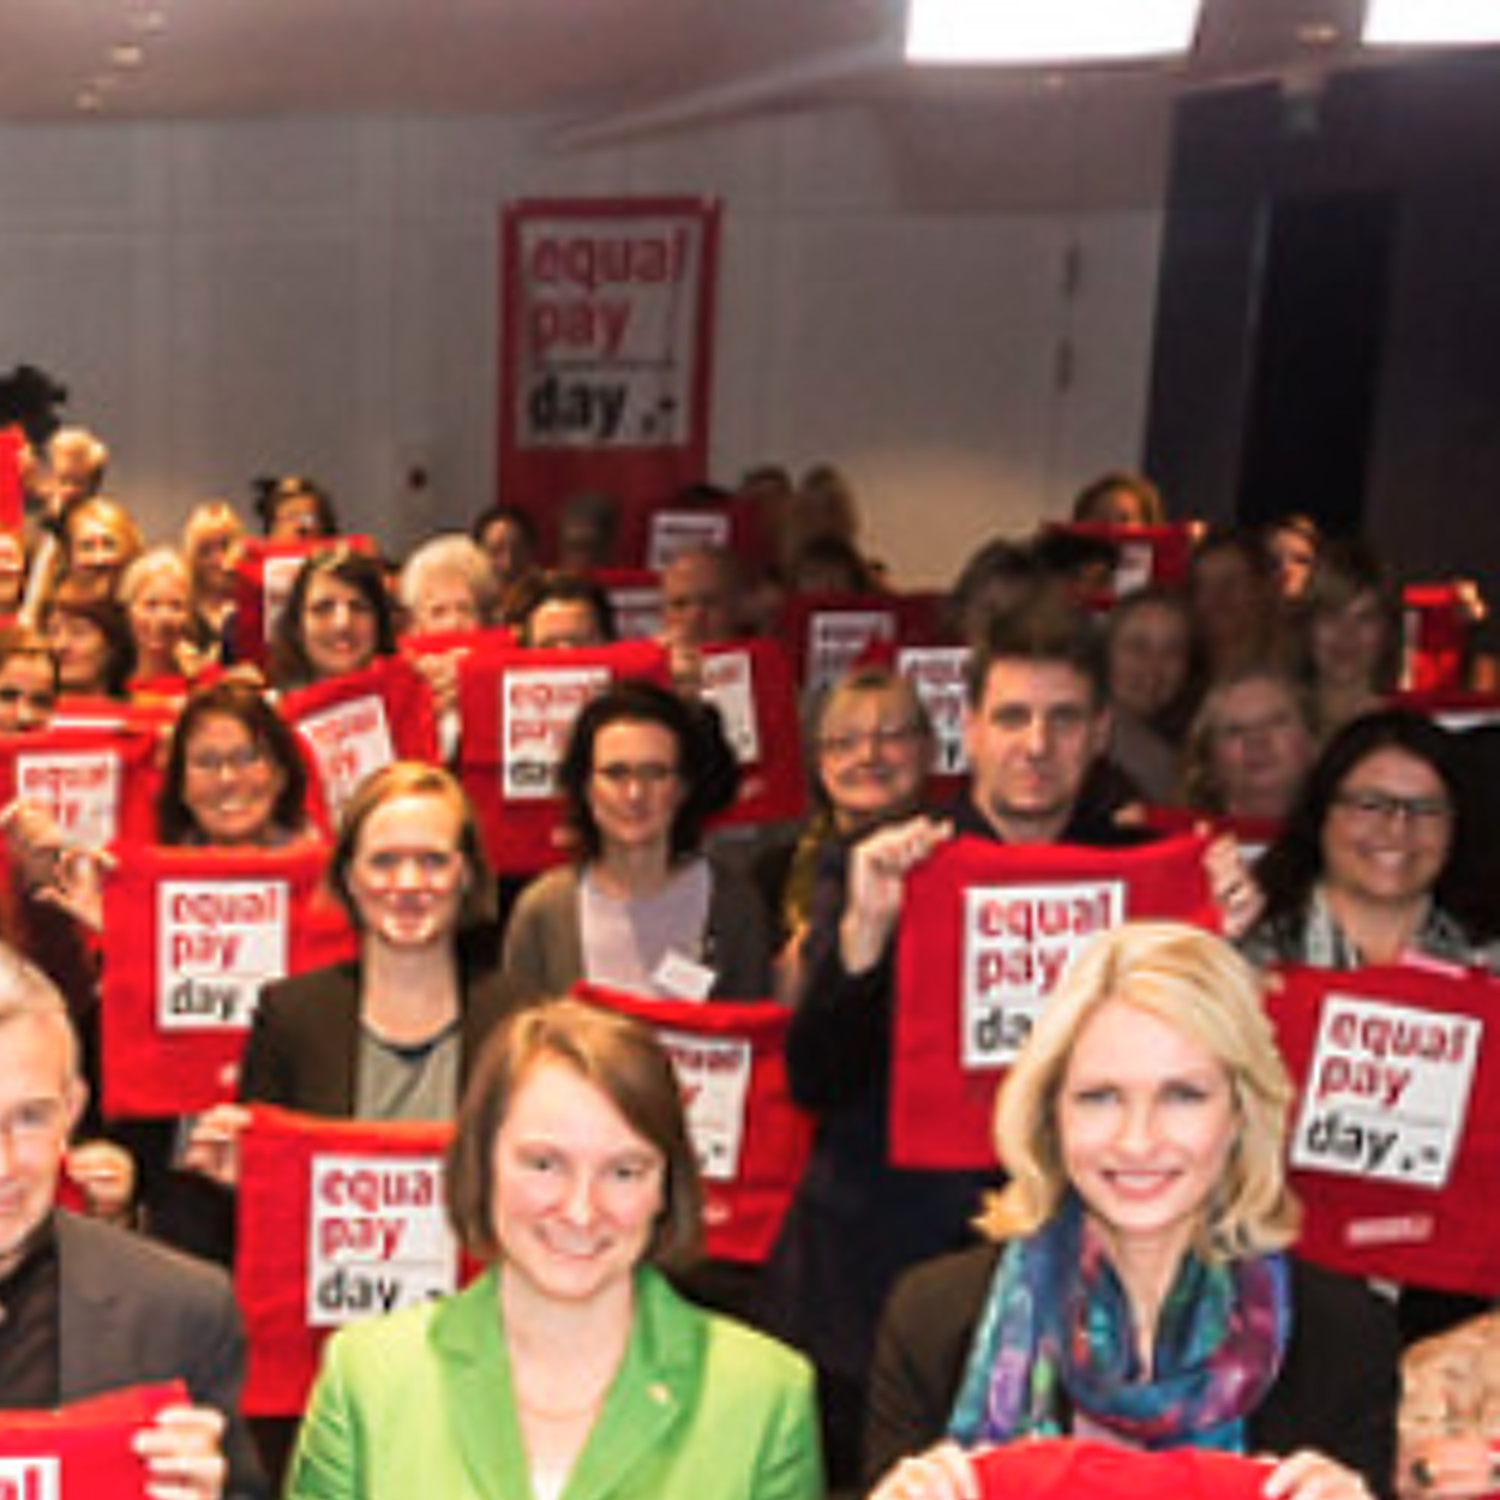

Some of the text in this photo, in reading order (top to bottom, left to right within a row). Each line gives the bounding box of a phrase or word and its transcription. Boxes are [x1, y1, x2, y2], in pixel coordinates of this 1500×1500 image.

[532, 228, 690, 292] equal
[531, 299, 631, 372] pay
[977, 892, 1113, 943] equal
[173, 933, 241, 970] pay
[977, 948, 1068, 996] pay
[974, 1007, 1034, 1051] da
[1329, 1010, 1467, 1064] equal
[1317, 1055, 1412, 1114] pay
[319, 1167, 436, 1213] equa
[319, 1215, 407, 1263] pay
